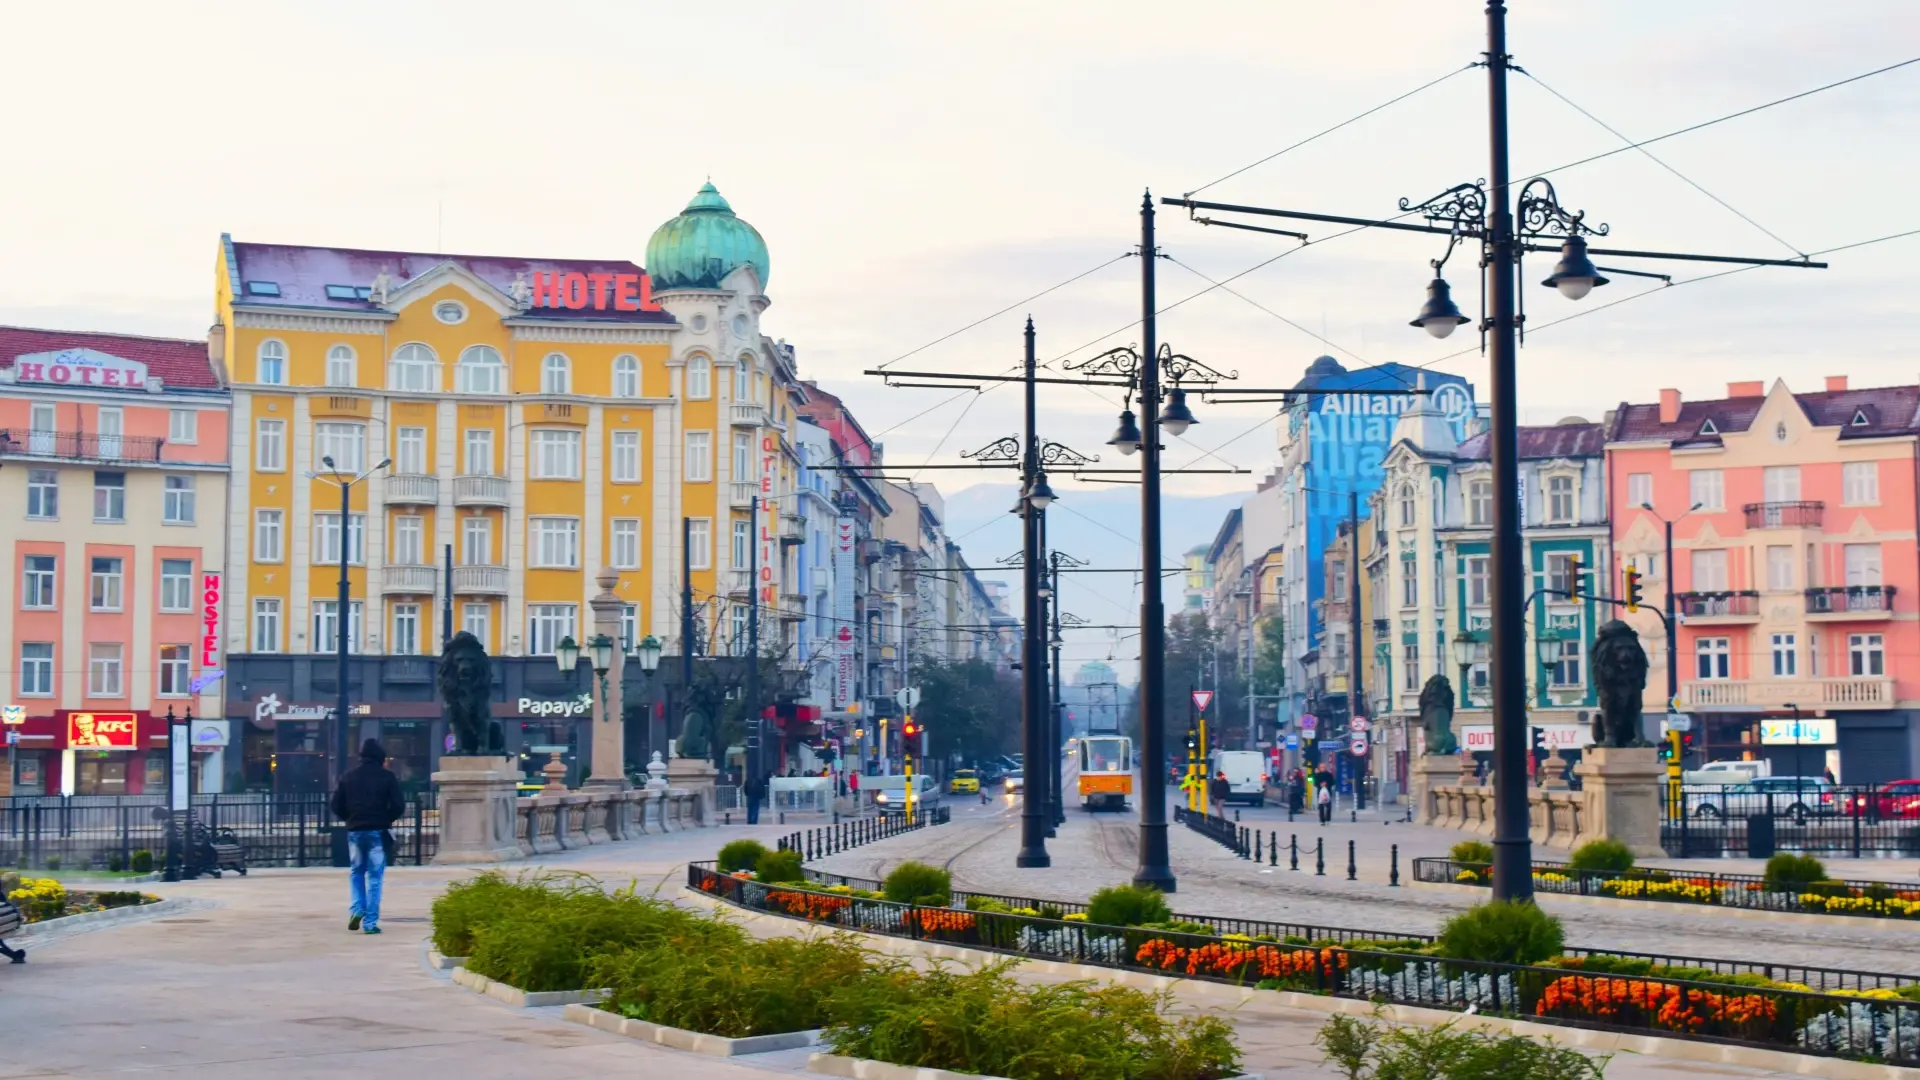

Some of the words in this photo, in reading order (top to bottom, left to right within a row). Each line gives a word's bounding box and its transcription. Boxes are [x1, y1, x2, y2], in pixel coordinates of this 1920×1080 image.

[533, 271, 661, 312] HOTEL
[18, 363, 143, 387] HOTEL
[760, 526, 773, 603] LION
[203, 575, 219, 667] HOSTEL
[288, 704, 315, 714] Pizza
[348, 704, 371, 715] Grill
[518, 698, 586, 718] Papaya
[96, 720, 133, 733] KFC
[1543, 730, 1577, 744] TALY
